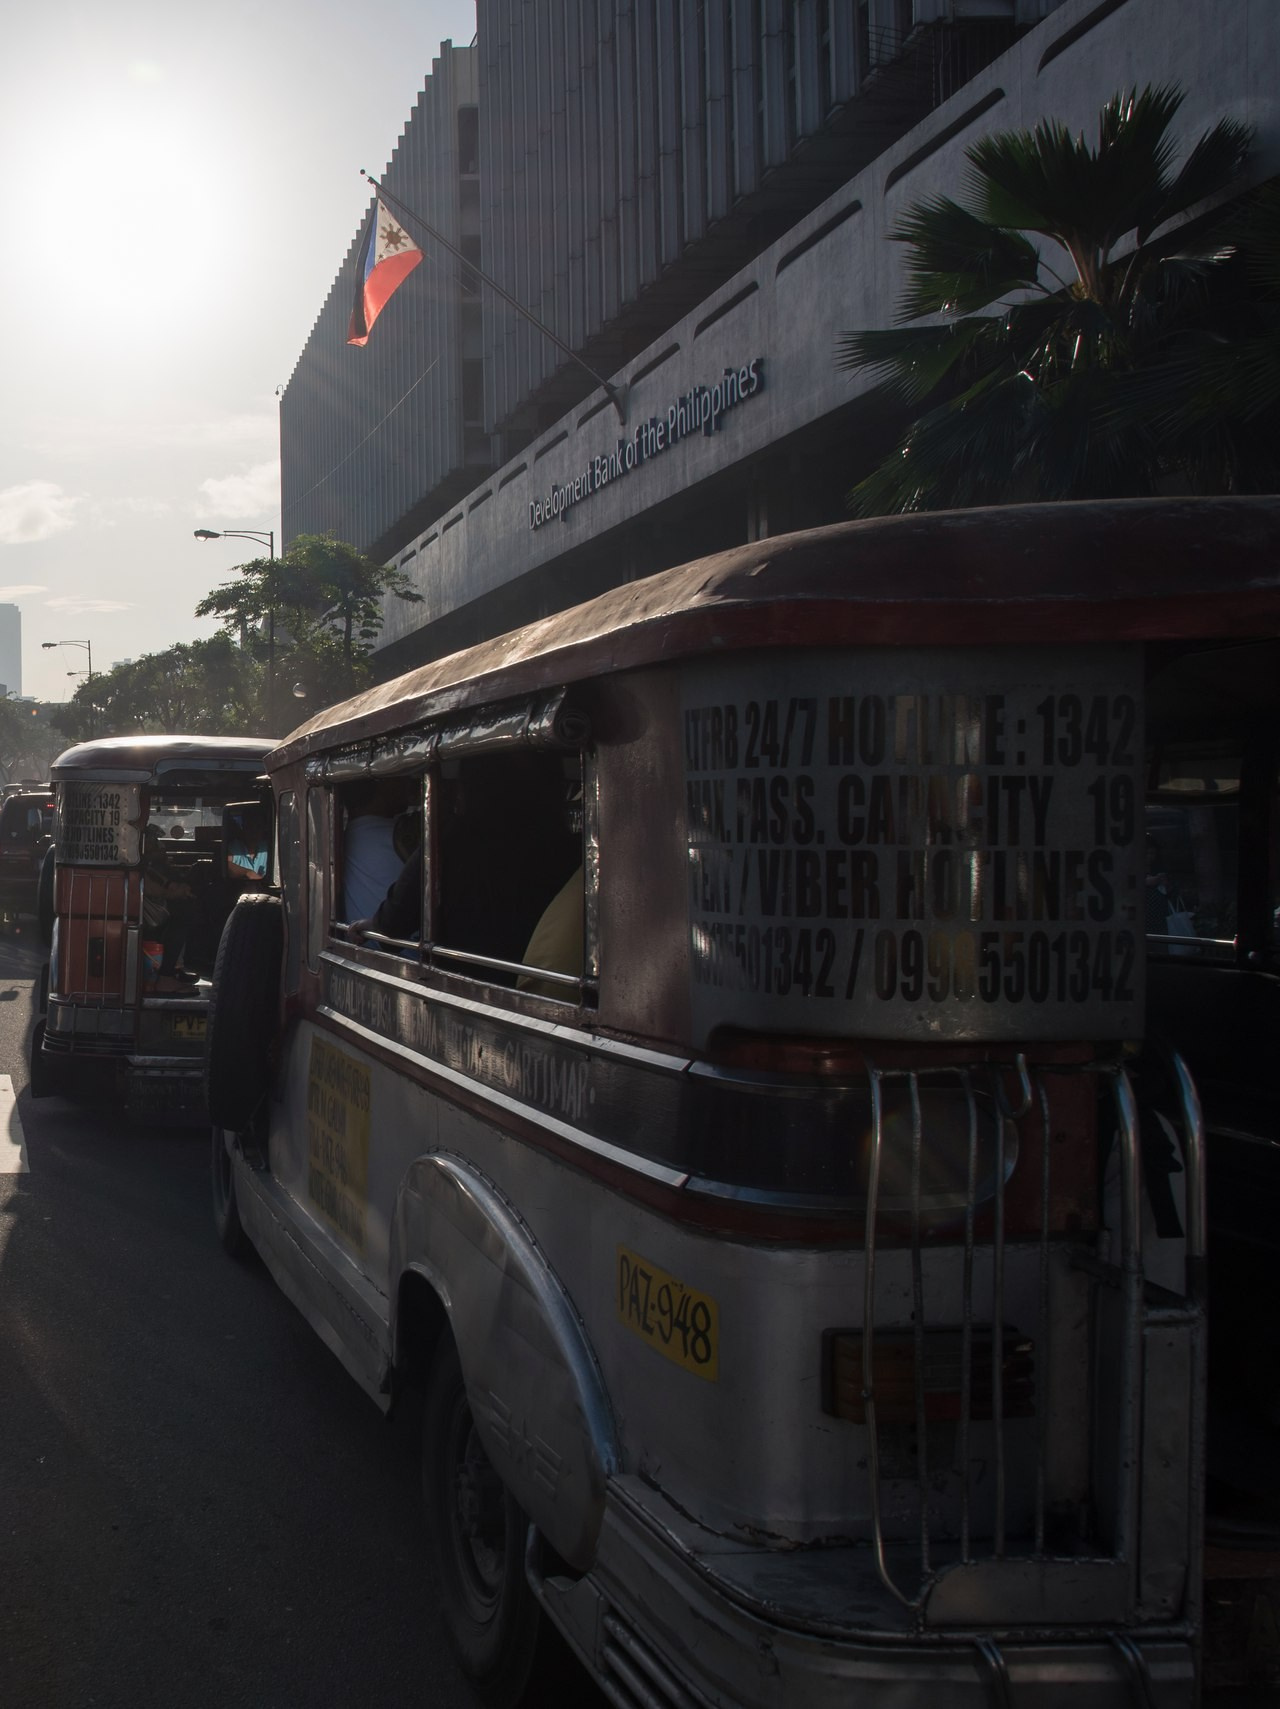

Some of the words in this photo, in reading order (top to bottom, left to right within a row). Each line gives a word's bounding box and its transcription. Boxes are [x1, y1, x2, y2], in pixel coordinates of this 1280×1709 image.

[529, 461, 591, 529] Development
[594, 441, 623, 489] Bank
[626, 426, 640, 469] of
[642, 419, 664, 459] the
[669, 359, 759, 443] Philippines
[684, 704, 738, 772] LTFRB
[744, 697, 818, 769] 24/7
[1036, 694, 1136, 768] 1342
[99, 793, 120, 809] 1342
[110, 811, 120, 827] 19
[737, 774, 824, 845] PASS.
[838, 774, 1054, 846] CAPACITY
[1087, 774, 1135, 847] 19
[758, 850, 880, 920] VIBER
[846, 929, 865, 1000] /
[620, 1254, 712, 1364] PAZ-948
